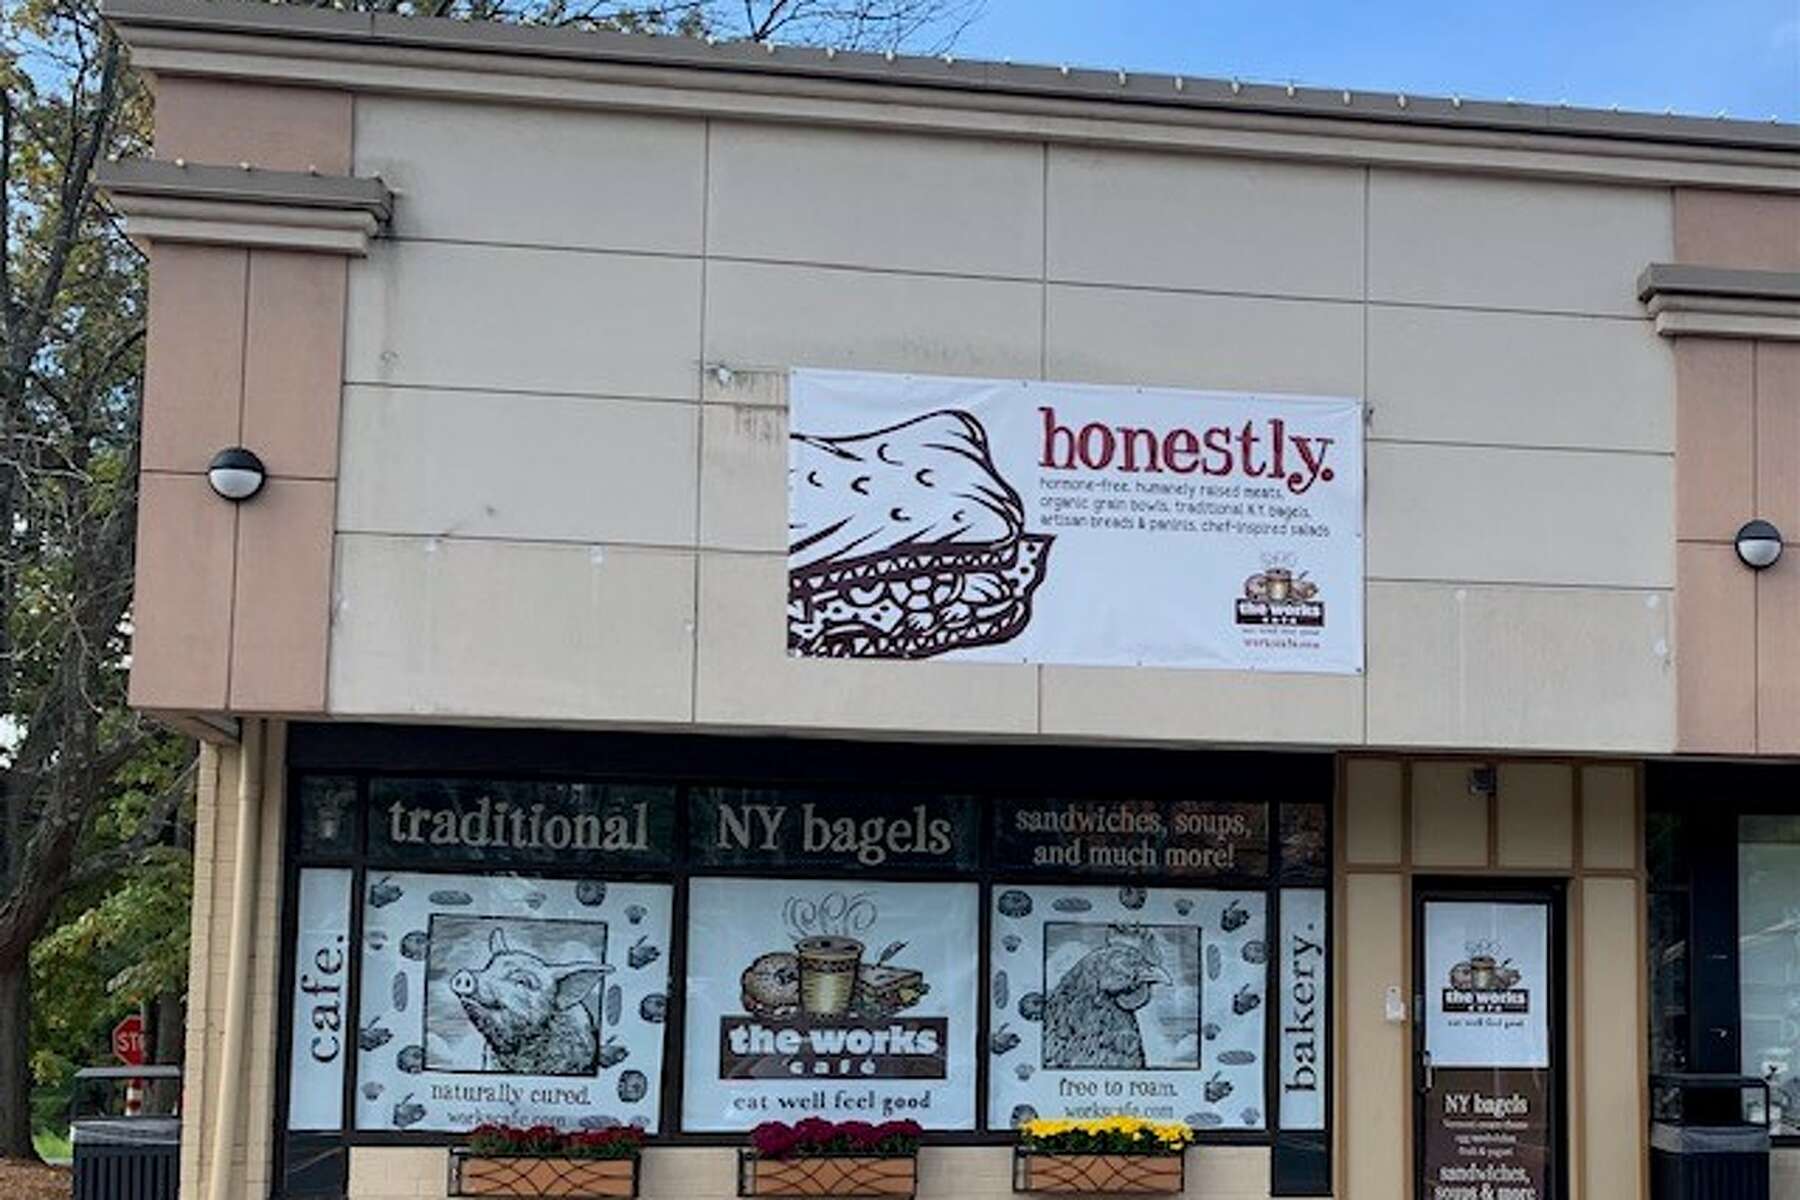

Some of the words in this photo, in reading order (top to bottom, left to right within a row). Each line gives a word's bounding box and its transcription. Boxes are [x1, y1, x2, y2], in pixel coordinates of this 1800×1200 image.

[1038, 406, 1334, 494] honestly.
[1135, 481, 1196, 499] humanely
[1200, 485, 1240, 498] raised
[1040, 496, 1088, 512] organic
[1093, 498, 1128, 514] grain
[1175, 500, 1243, 515] traditional
[1040, 514, 1087, 526] artisan
[1090, 515, 1134, 529] breads
[1138, 516, 1145, 529] &
[1201, 520, 1287, 536] chef-inspired
[388, 796, 649, 851] traditional
[717, 803, 788, 850] NY
[801, 802, 952, 866] bagels
[1015, 804, 1169, 838] sandwiches,
[1174, 811, 1252, 841] soups,
[1033, 840, 1081, 867] and
[1088, 842, 1158, 868] much
[1165, 844, 1236, 869] more!
[301, 934, 345, 1063] cafe.
[1284, 923, 1323, 1094] bakery.
[1445, 989, 1474, 1004] the
[1475, 989, 1526, 1005] works
[729, 1024, 801, 1056] the
[808, 1025, 939, 1056] works
[431, 1084, 524, 1106] naturally
[530, 1085, 592, 1106] cured.
[1060, 1077, 1098, 1096] free
[1104, 1081, 1124, 1096] to
[1129, 1081, 1179, 1097] roam.
[733, 1093, 768, 1110] eat
[777, 1090, 826, 1110] well
[834, 1090, 876, 1110] feel
[882, 1091, 931, 1117] good
[1445, 1094, 1471, 1113] NY
[1473, 1092, 1529, 1118] bagels
[1439, 1162, 1531, 1185] sandwiches,
[1480, 1182, 1495, 1200] &
